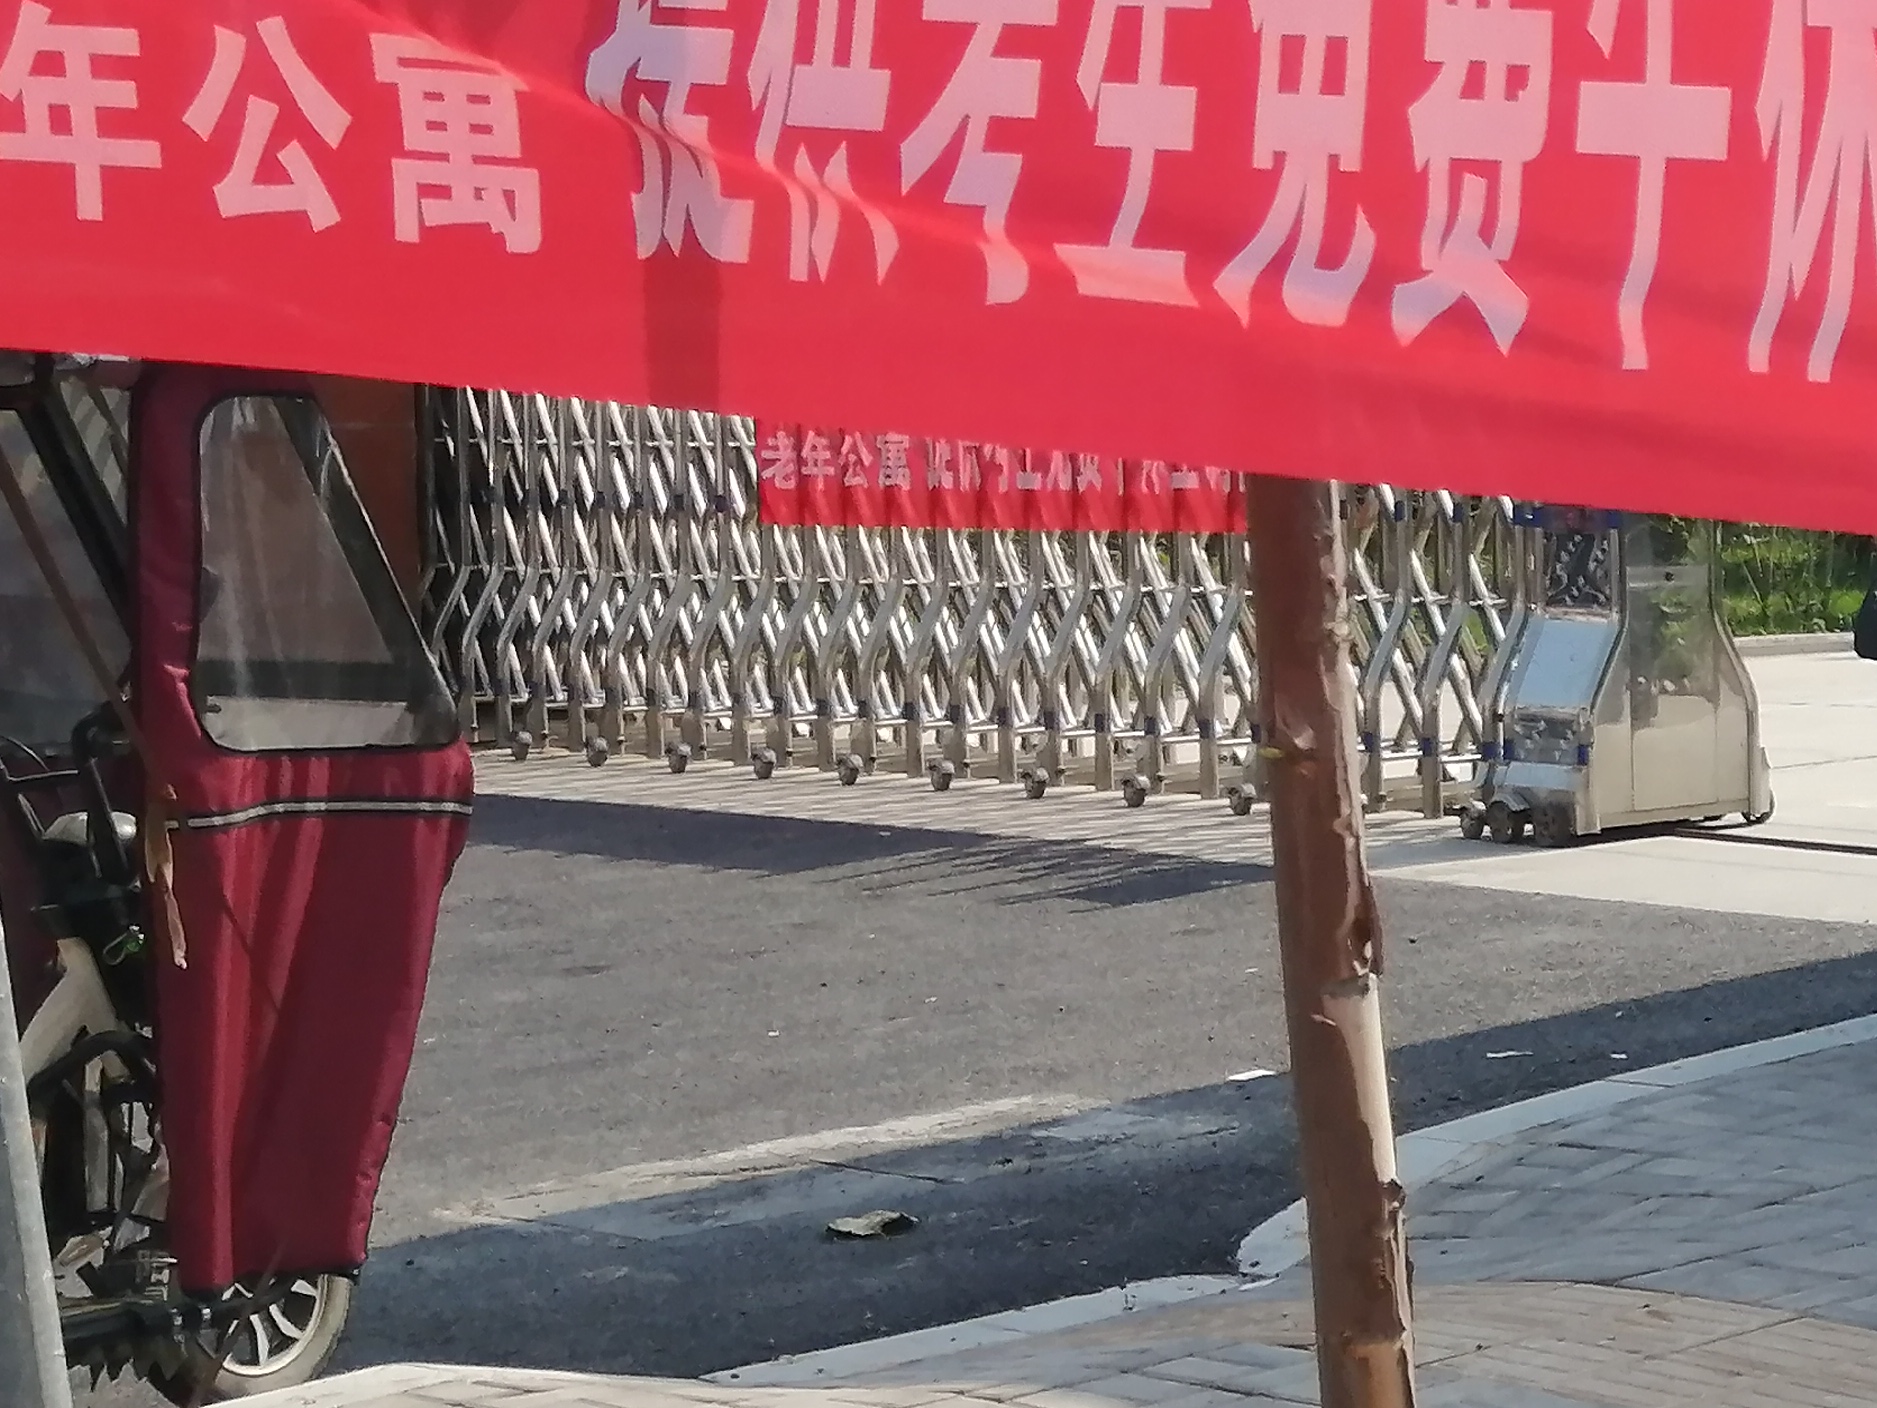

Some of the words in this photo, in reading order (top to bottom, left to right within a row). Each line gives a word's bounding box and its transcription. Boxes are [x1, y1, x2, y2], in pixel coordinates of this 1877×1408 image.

[0, 0, 542, 255] 年公寓
[761, 430, 911, 491] 老年公寓
